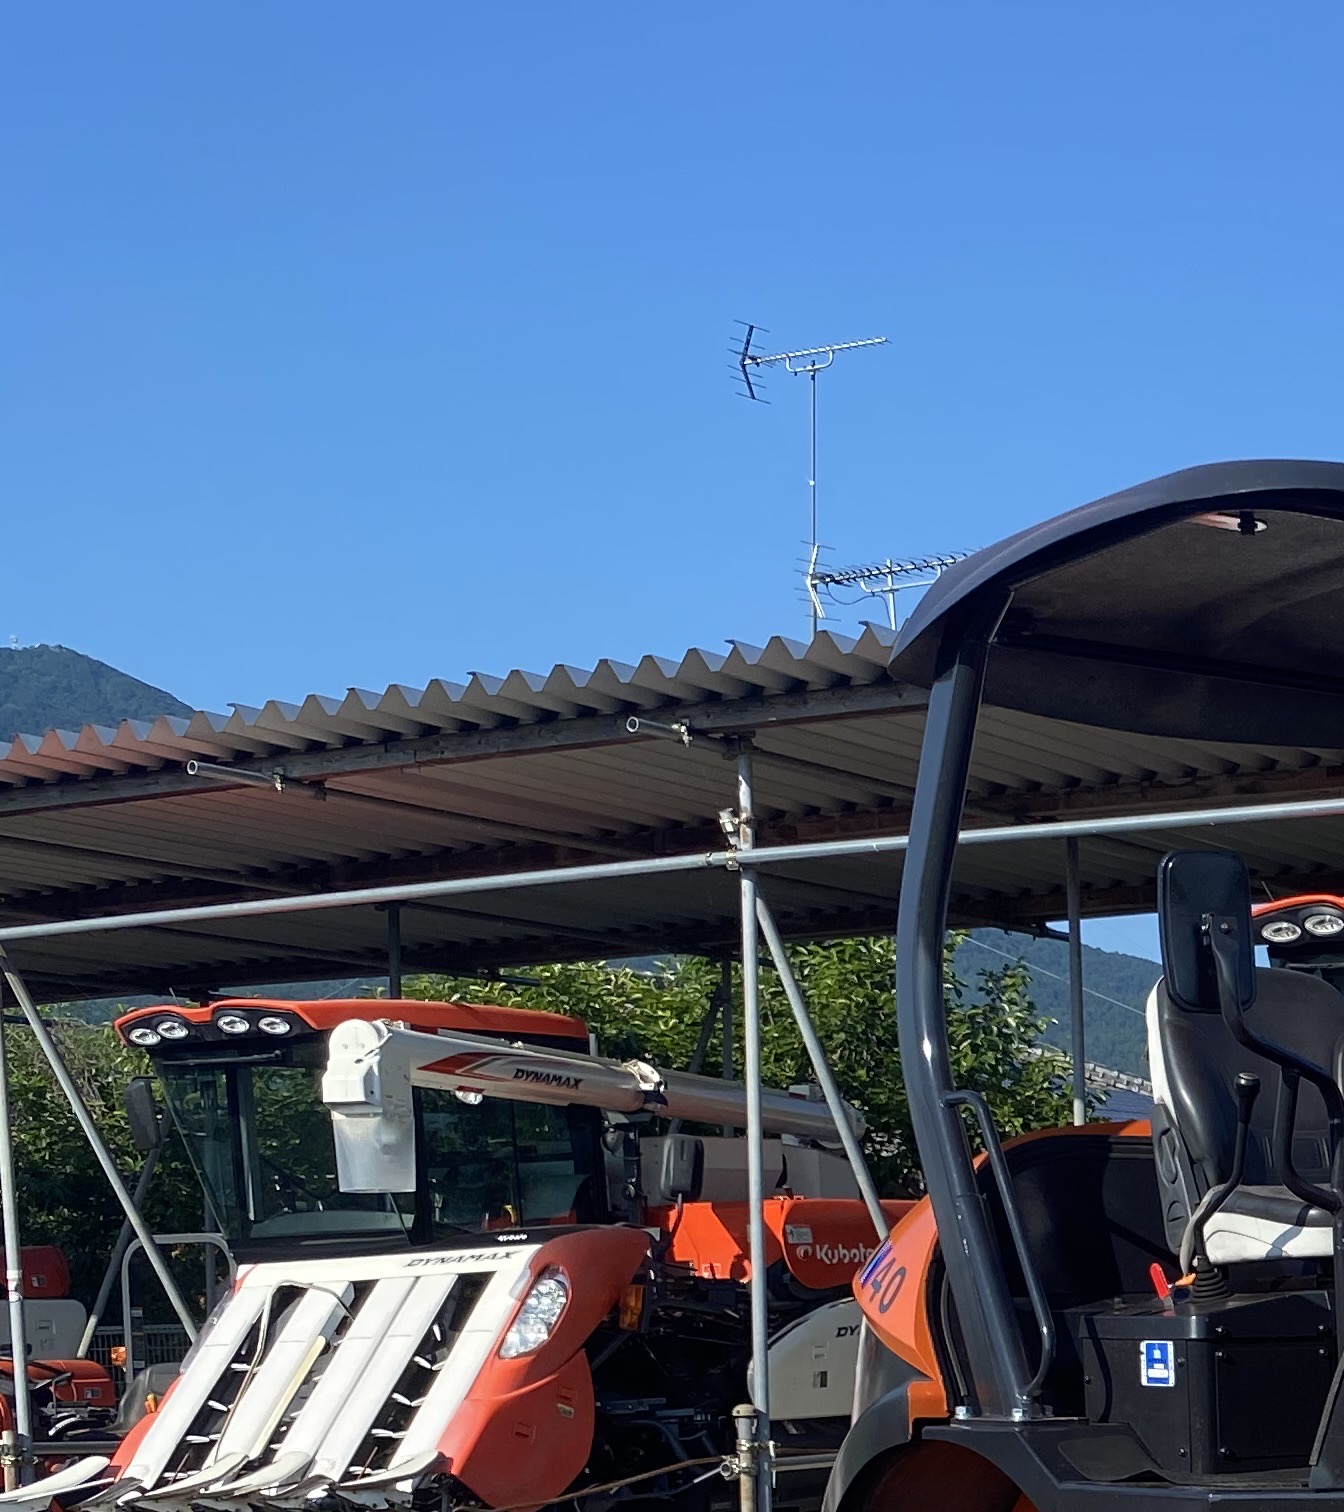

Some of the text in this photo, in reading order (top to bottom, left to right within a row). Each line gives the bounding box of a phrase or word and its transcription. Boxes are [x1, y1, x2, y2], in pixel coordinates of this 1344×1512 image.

[513, 1068, 584, 1090] DYNAMAX
[403, 1250, 523, 1268] DYNAMAX
[835, 1324, 862, 1338] DY
